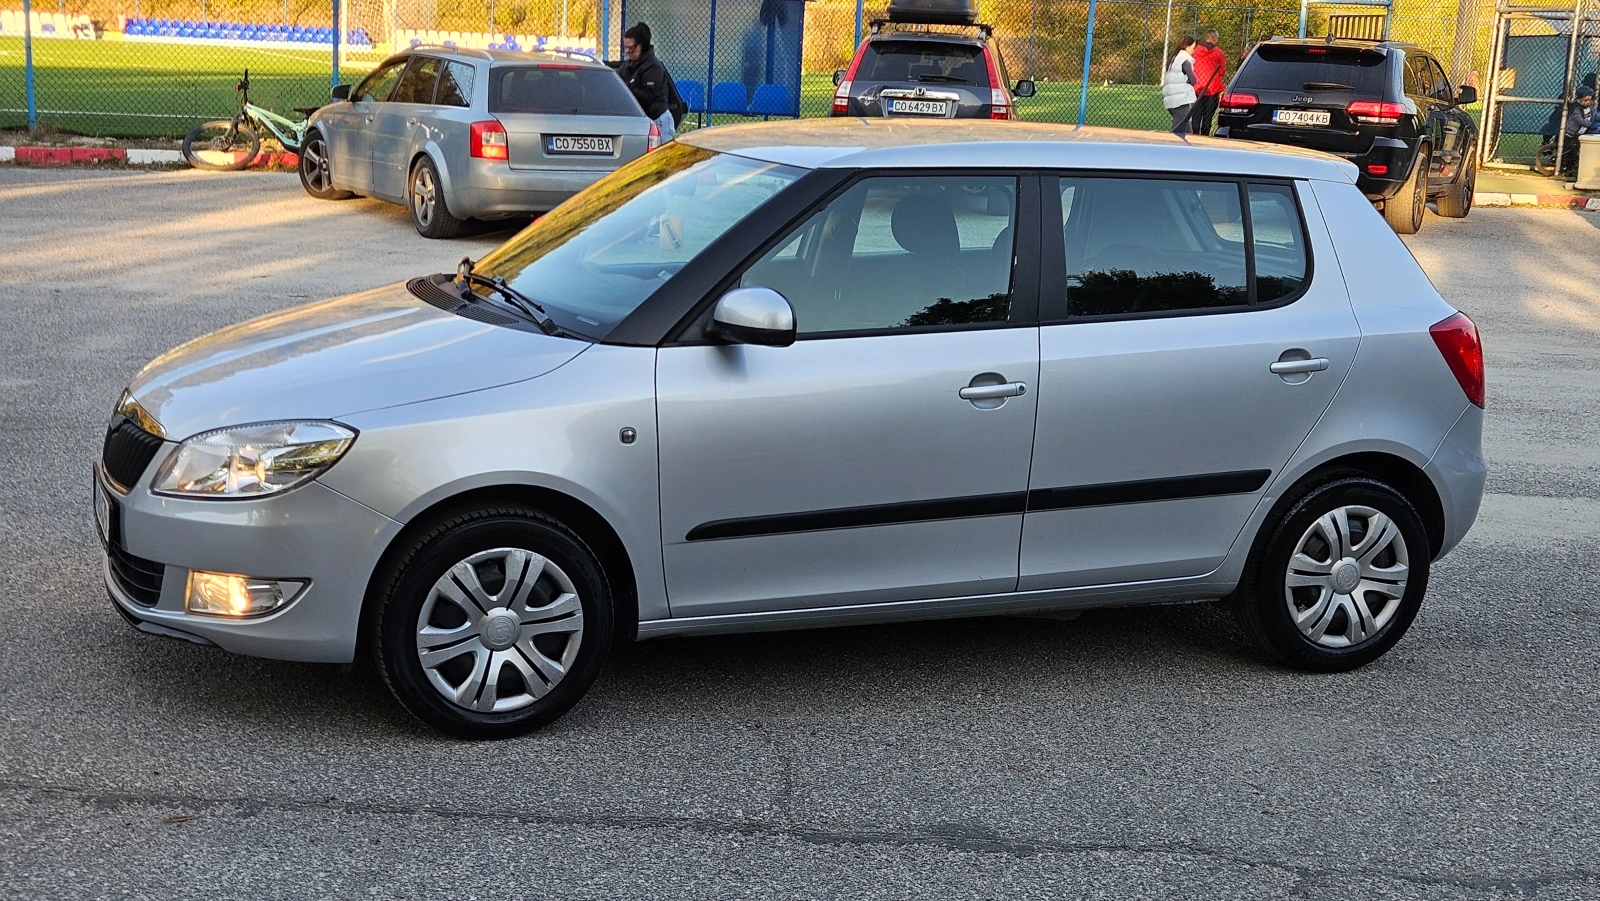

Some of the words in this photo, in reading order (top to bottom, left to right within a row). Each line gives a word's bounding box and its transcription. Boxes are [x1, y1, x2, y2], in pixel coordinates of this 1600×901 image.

[1292, 95, 1313, 103] Jeep
[895, 102, 906, 111] CO
[908, 102, 930, 112] 6429
[932, 103, 944, 113] BX
[1279, 112, 1290, 121] CO
[1292, 112, 1314, 122] 7404
[1316, 114, 1328, 123] KB
[555, 138, 569, 149] CO
[571, 138, 596, 150] 7550
[598, 138, 611, 150] BX
